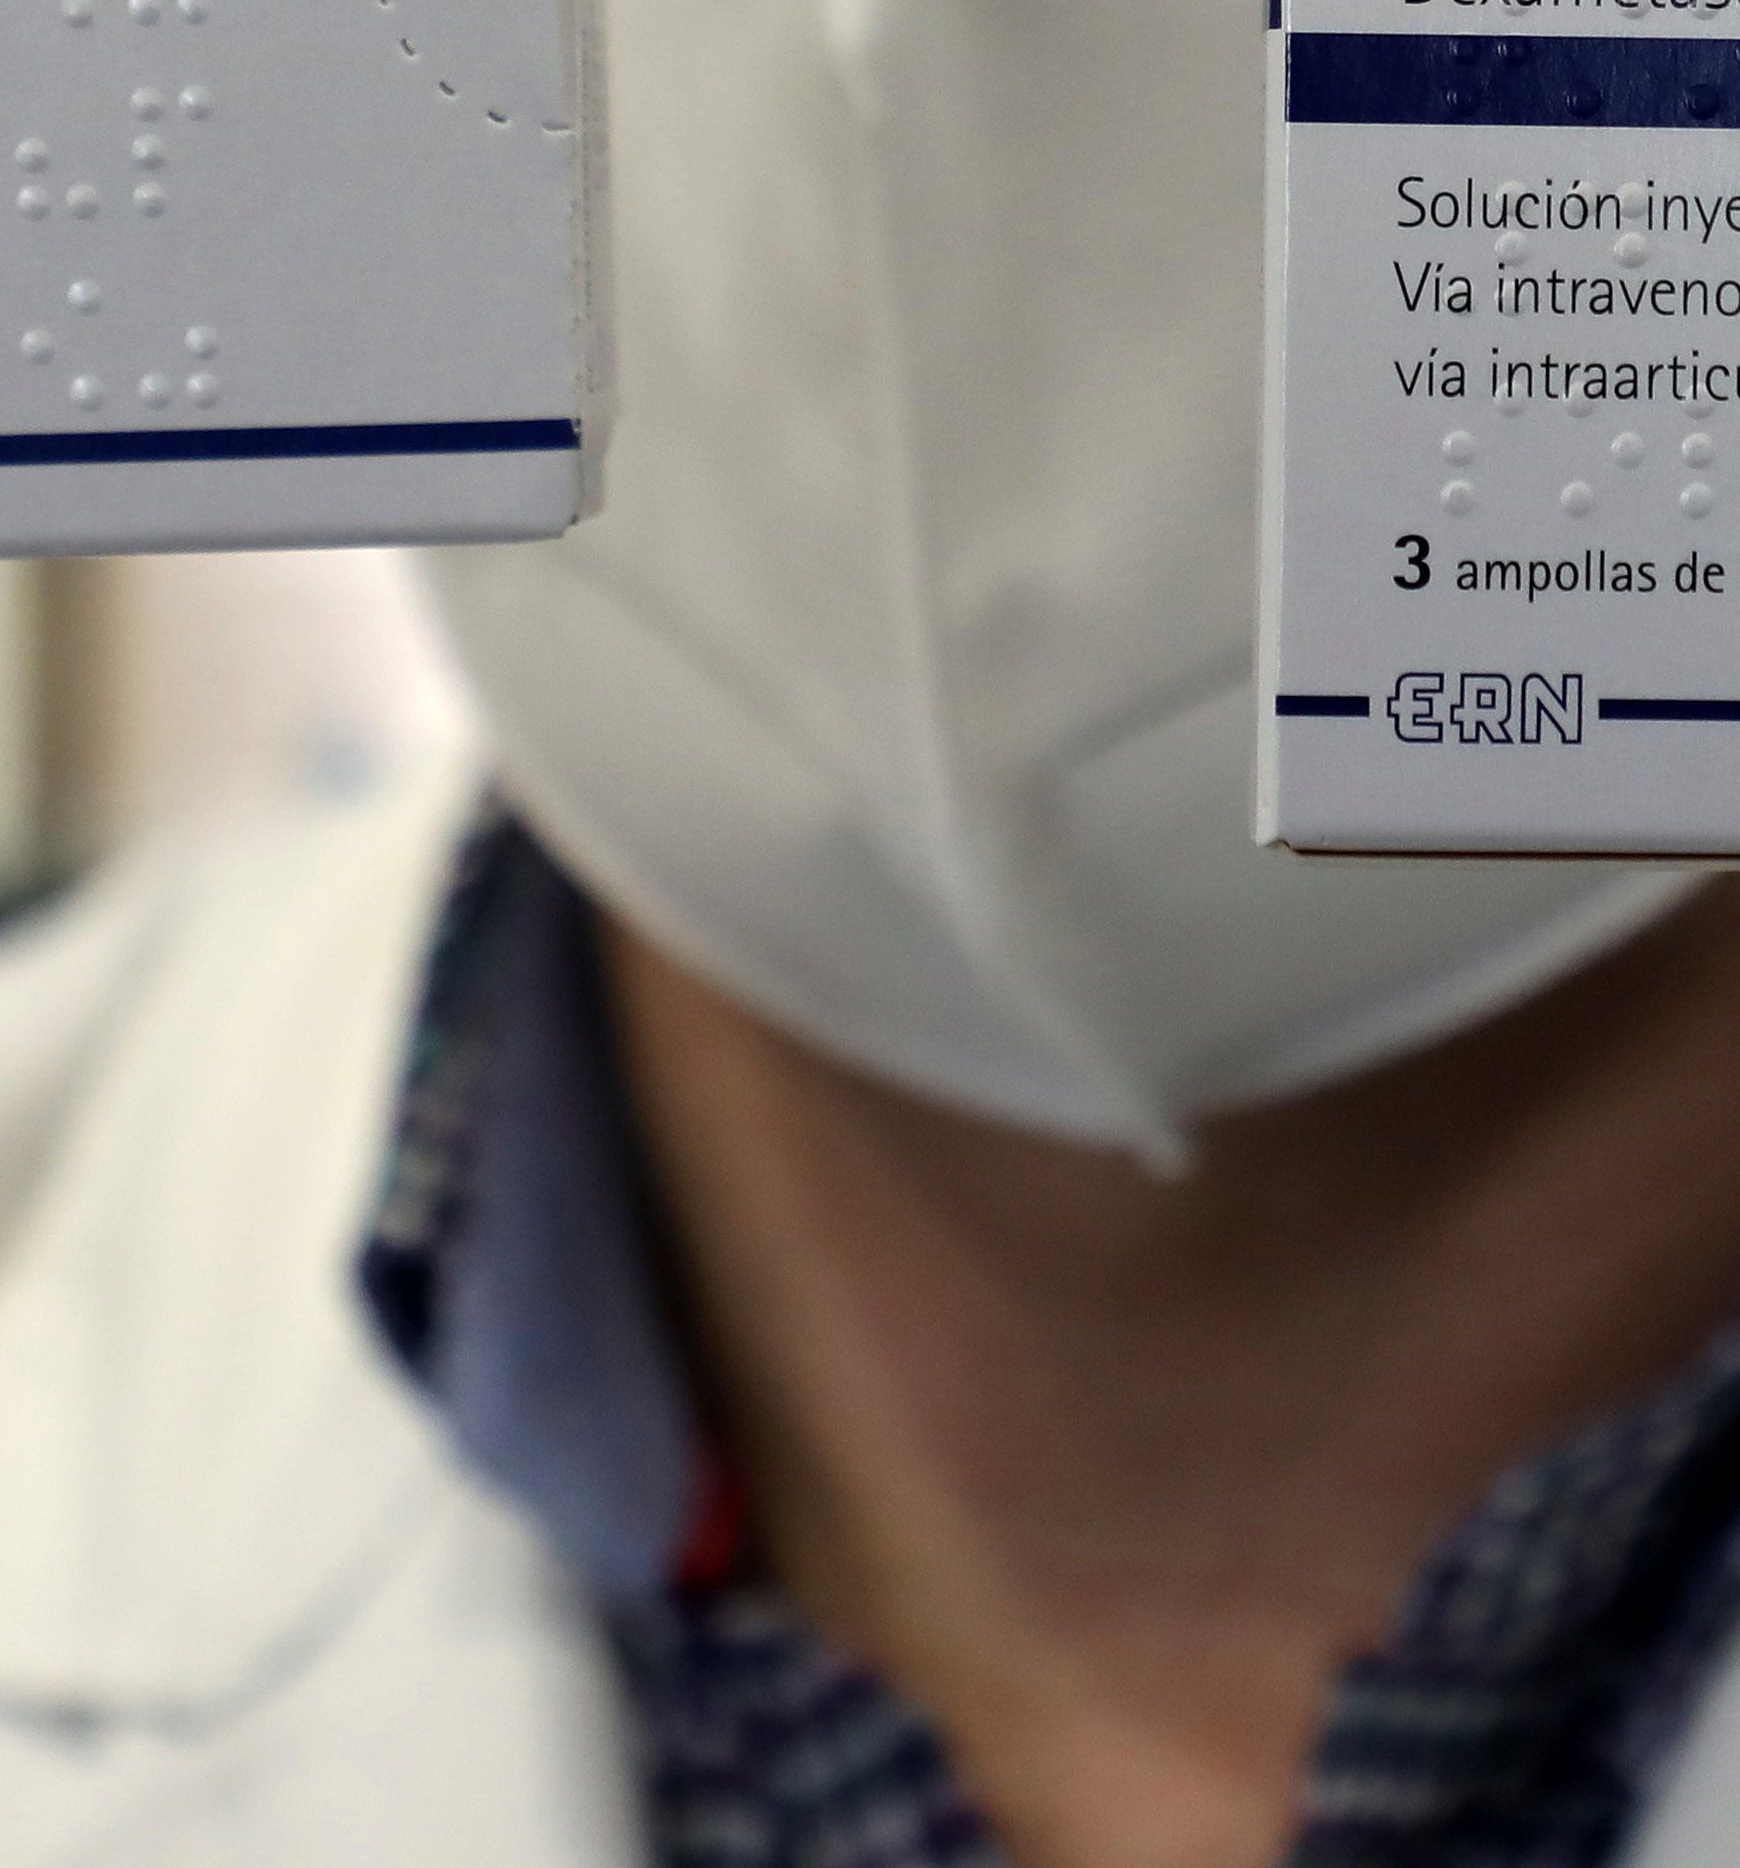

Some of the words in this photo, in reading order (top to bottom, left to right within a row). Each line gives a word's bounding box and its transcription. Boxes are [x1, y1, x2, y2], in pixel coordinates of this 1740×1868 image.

[1397, 176, 1621, 230] Solución
[1393, 261, 1472, 314] Vía
[1394, 347, 1465, 398] vía
[1393, 534, 1431, 590] 3
[1456, 549, 1657, 603] ampollas
[1674, 550, 1725, 594] de
[1386, 671, 1583, 745] ERN
